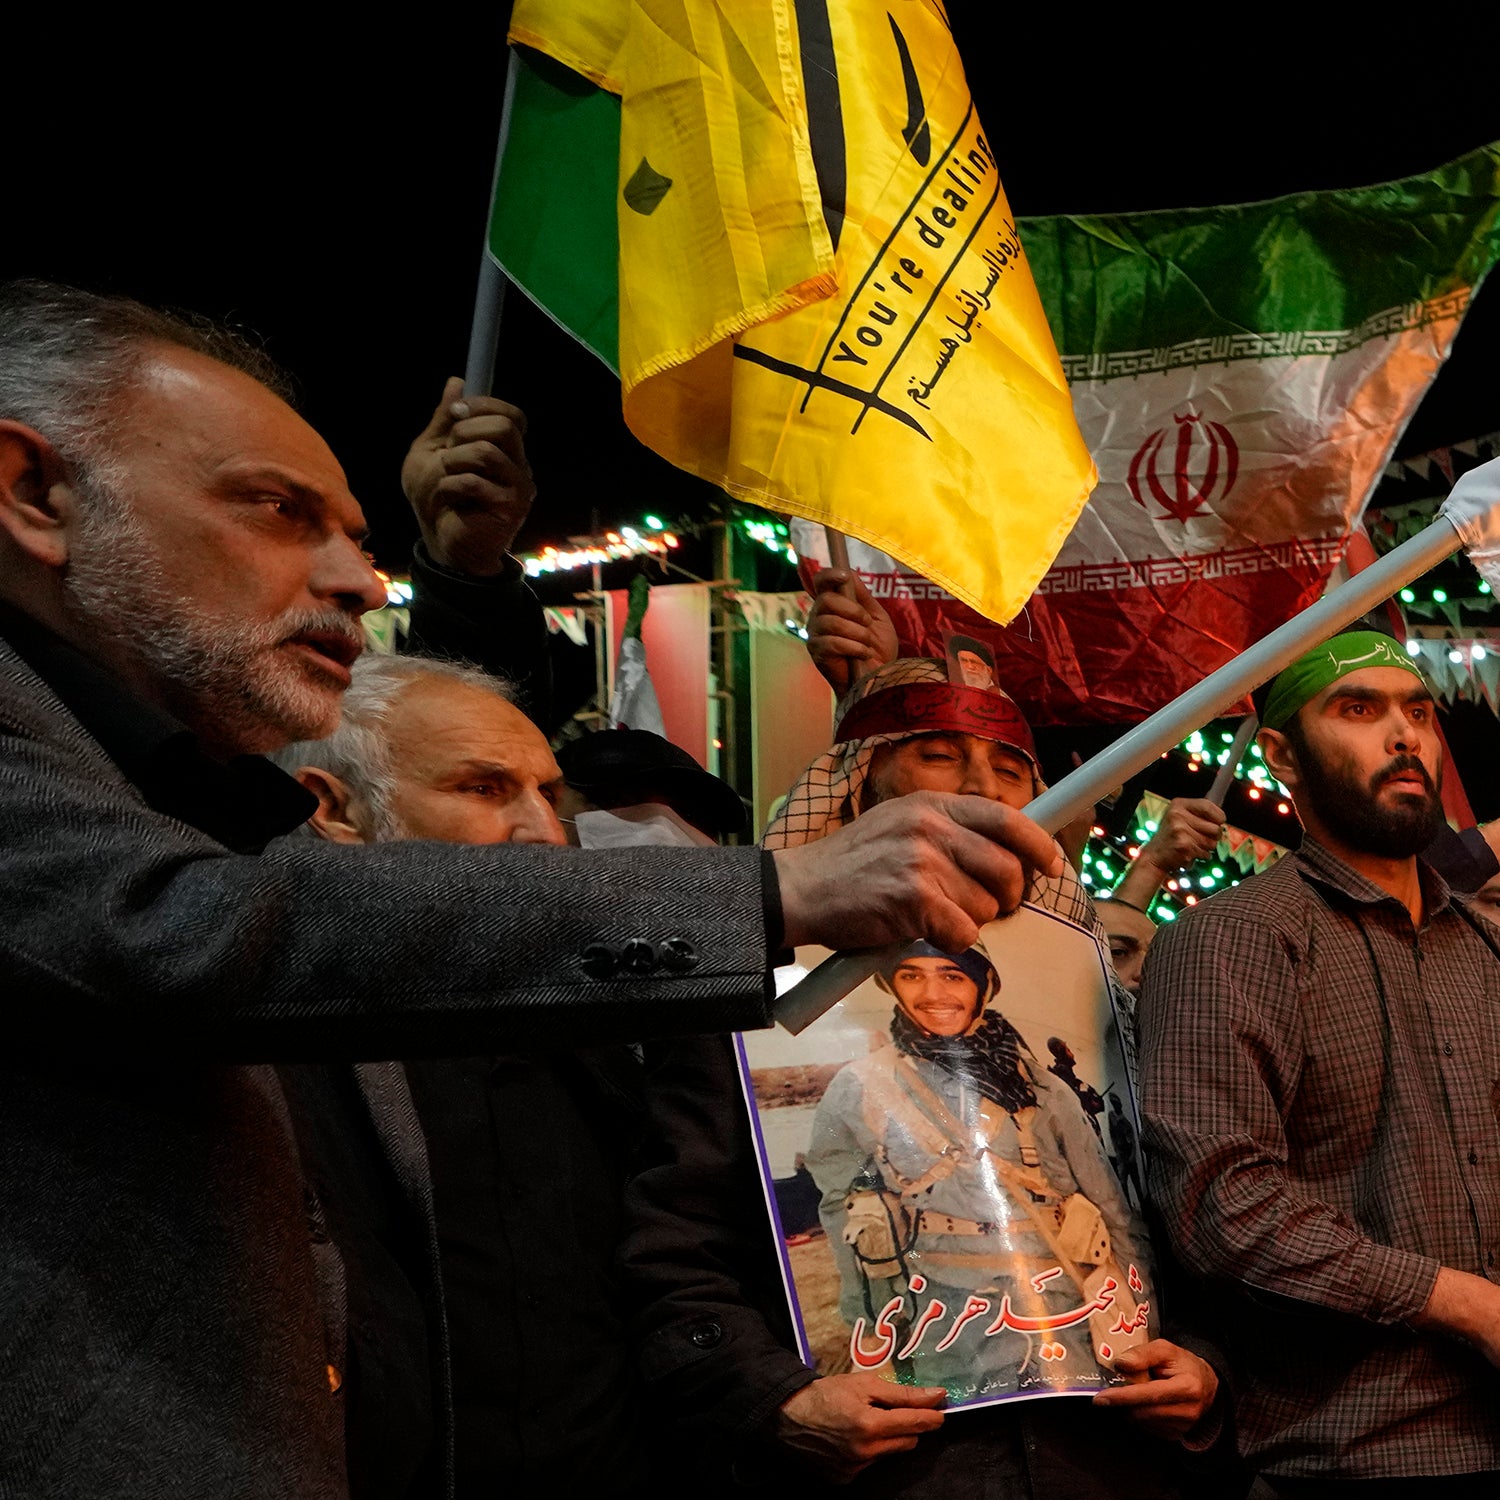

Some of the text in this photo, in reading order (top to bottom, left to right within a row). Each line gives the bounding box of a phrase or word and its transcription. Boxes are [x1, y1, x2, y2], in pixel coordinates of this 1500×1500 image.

[832, 256, 924, 366] You're
[914, 133, 998, 249] dealing
[849, 1273, 992, 1370] هرمزی
